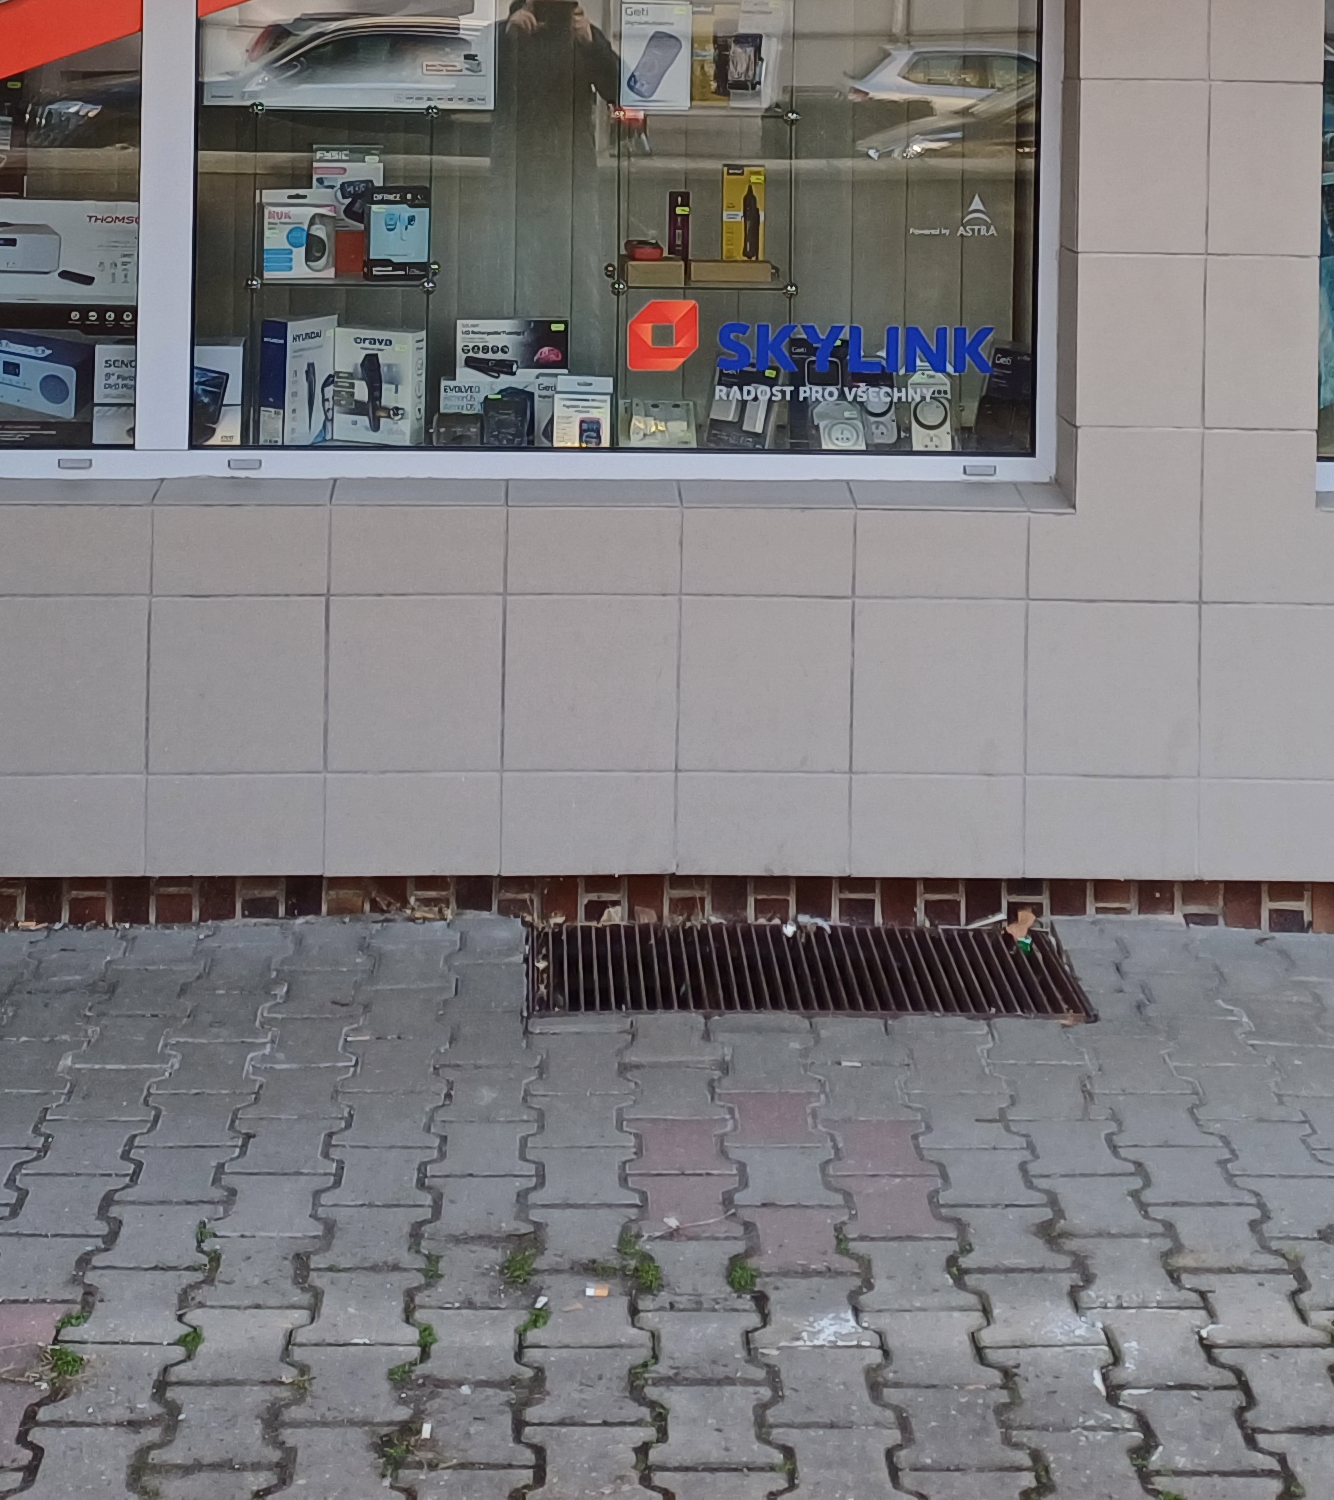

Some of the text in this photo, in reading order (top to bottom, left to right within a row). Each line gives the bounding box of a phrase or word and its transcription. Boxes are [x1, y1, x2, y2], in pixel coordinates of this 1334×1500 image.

[624, 6, 649, 18] Geti
[956, 225, 998, 237] ASTRA
[716, 321, 996, 374] SKYLINK
[714, 382, 935, 403] RADOST PRO VŠECHNY
